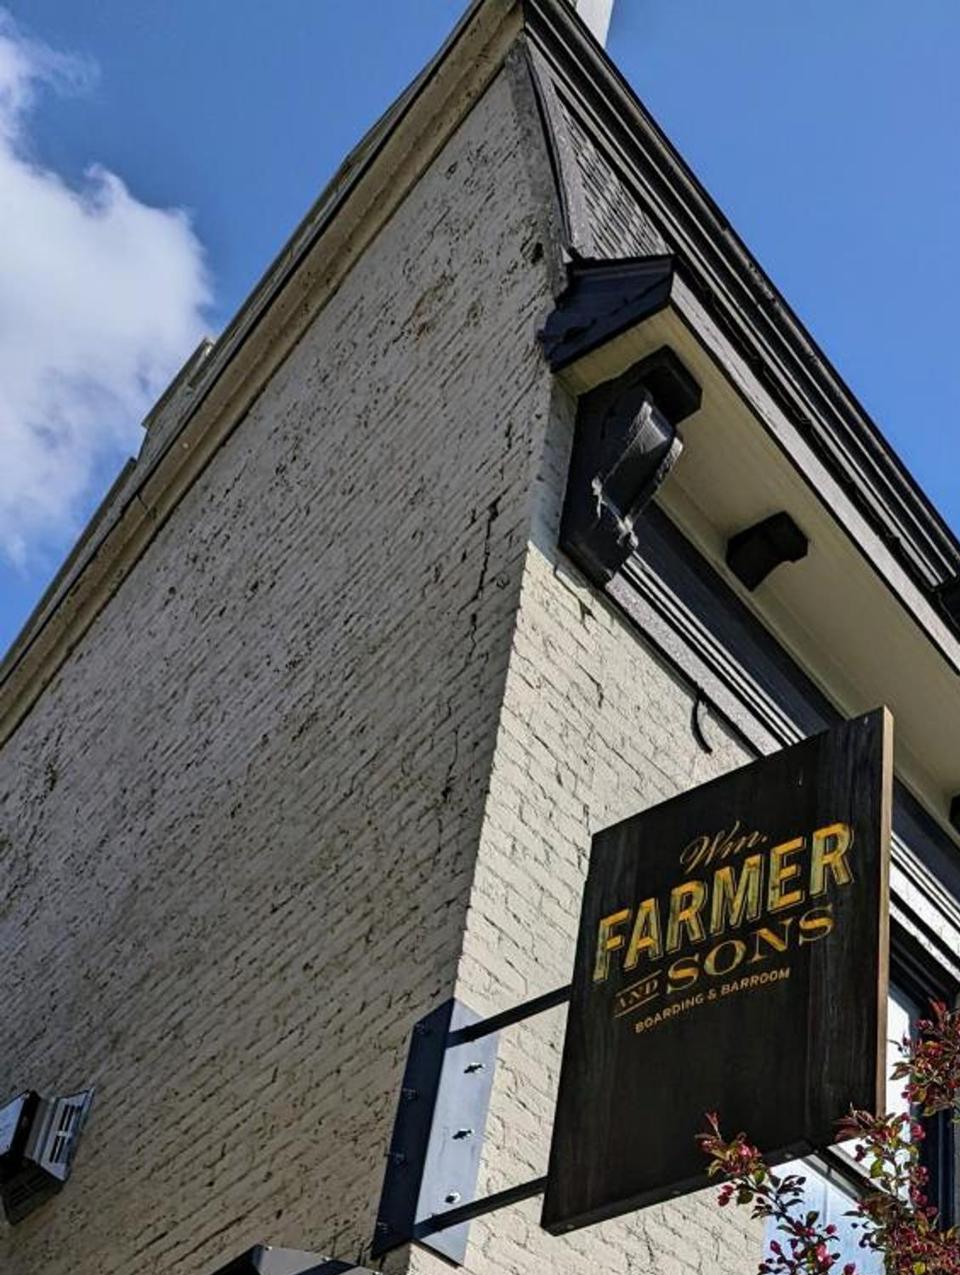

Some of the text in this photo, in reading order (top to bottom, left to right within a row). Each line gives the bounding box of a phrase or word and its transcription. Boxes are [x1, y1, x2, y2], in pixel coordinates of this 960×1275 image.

[592, 821, 854, 982] FARMER
[615, 903, 834, 1013] AND SONS
[635, 967, 791, 1033] BOARDING & BARROOM
